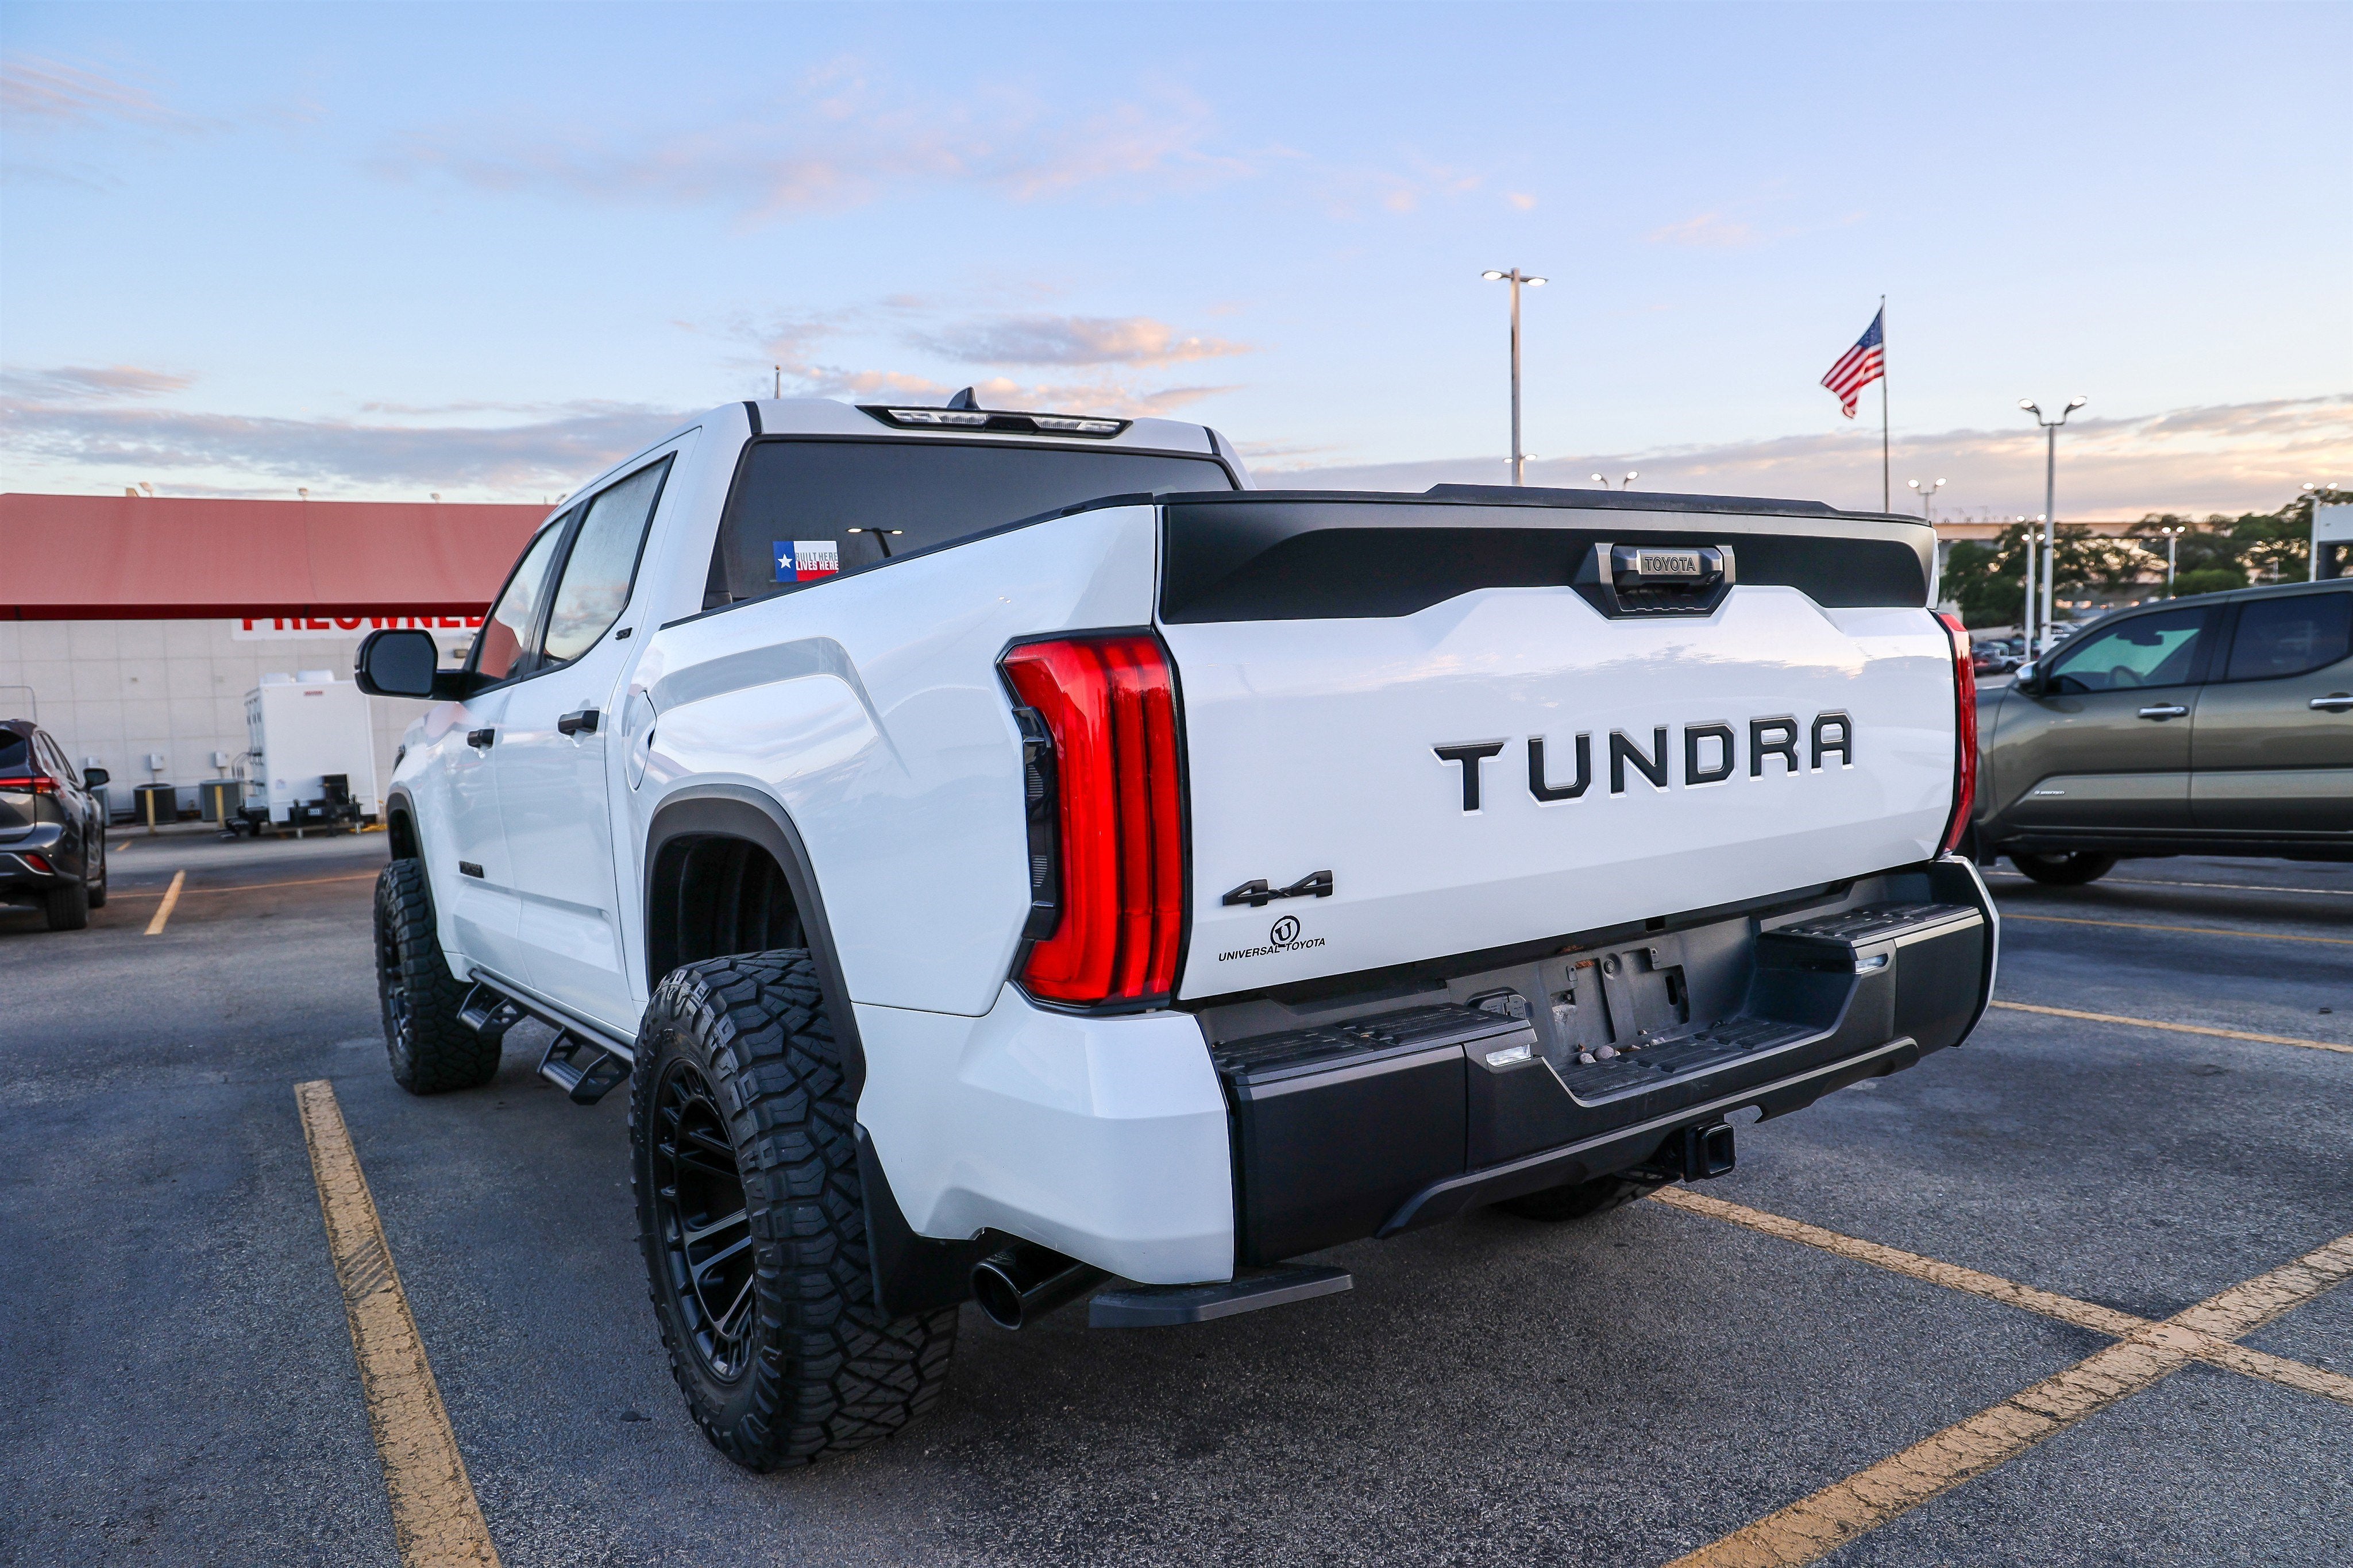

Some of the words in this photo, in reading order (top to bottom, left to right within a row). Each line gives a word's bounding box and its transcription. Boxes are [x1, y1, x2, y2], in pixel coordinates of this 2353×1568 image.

[796, 552, 817, 561] BUILT
[819, 552, 838, 561] HERE
[1644, 556, 1696, 572] TOYOTA
[796, 561, 818, 570] LIVES
[819, 561, 839, 570] HERE
[1432, 711, 1853, 813] TUNDRA
[1218, 945, 1280, 962] UNIVERSAL
[1285, 937, 1326, 952] TOYOTA
